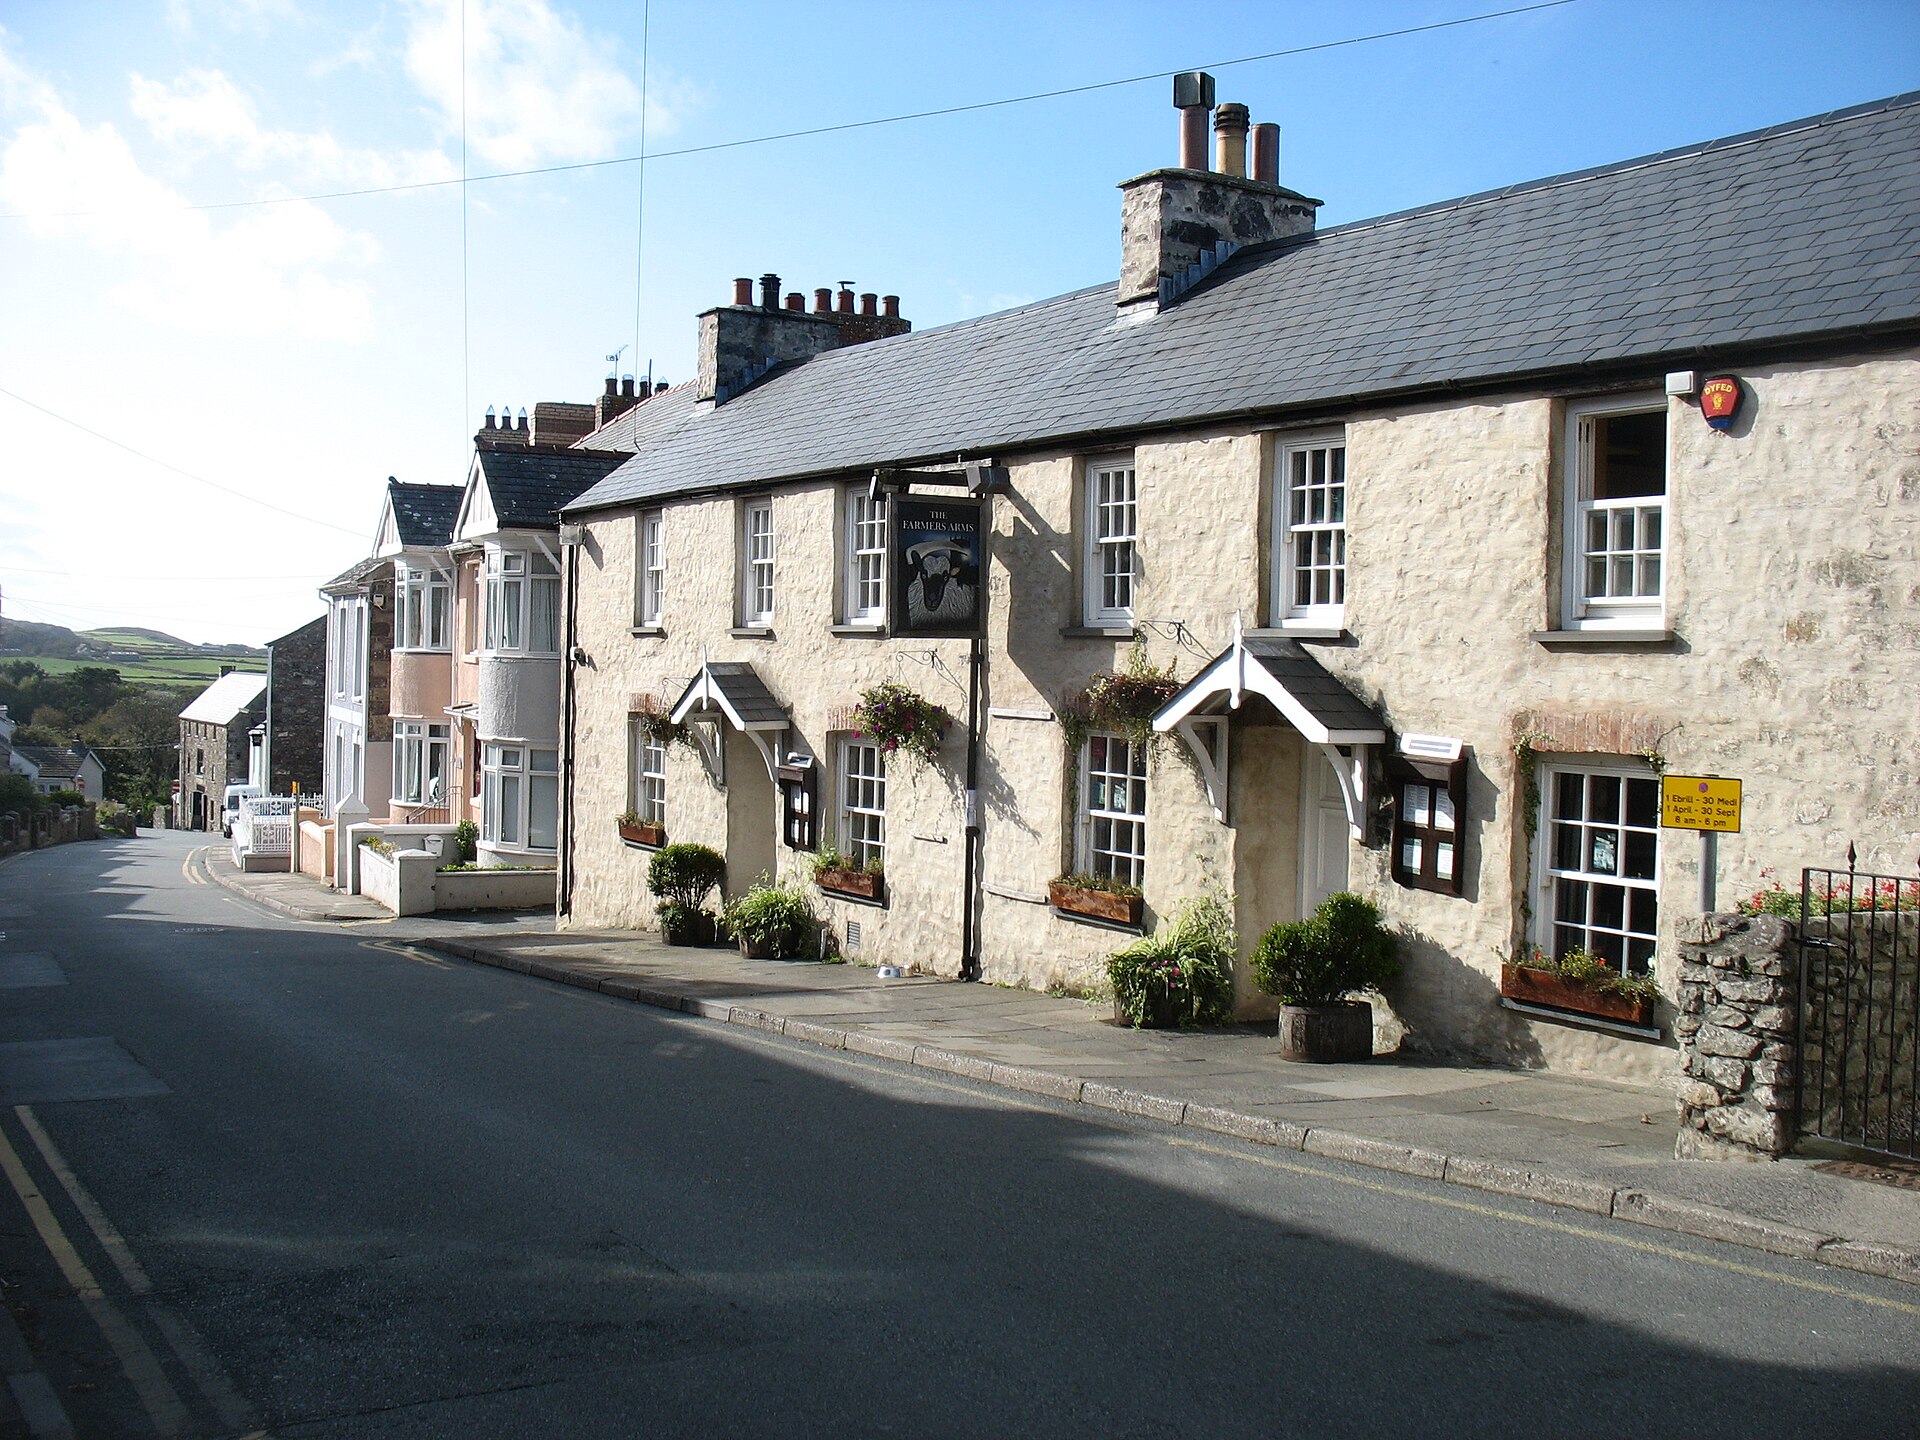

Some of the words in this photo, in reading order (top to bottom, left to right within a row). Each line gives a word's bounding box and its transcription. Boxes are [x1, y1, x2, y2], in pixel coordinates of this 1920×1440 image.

[1704, 383, 1732, 395] DYFED
[929, 510, 948, 519] THE
[903, 520, 946, 531] FARMERS
[947, 522, 974, 532] ARMS
[1672, 794, 1693, 803] Ebrill
[1702, 796, 1714, 805] 30
[1717, 797, 1737, 806] Medi
[1673, 805, 1692, 814] April
[1701, 807, 1713, 815] 30
[1716, 807, 1736, 817] Sept
[1675, 815, 1680, 823] 8
[1704, 817, 1710, 825] 6
